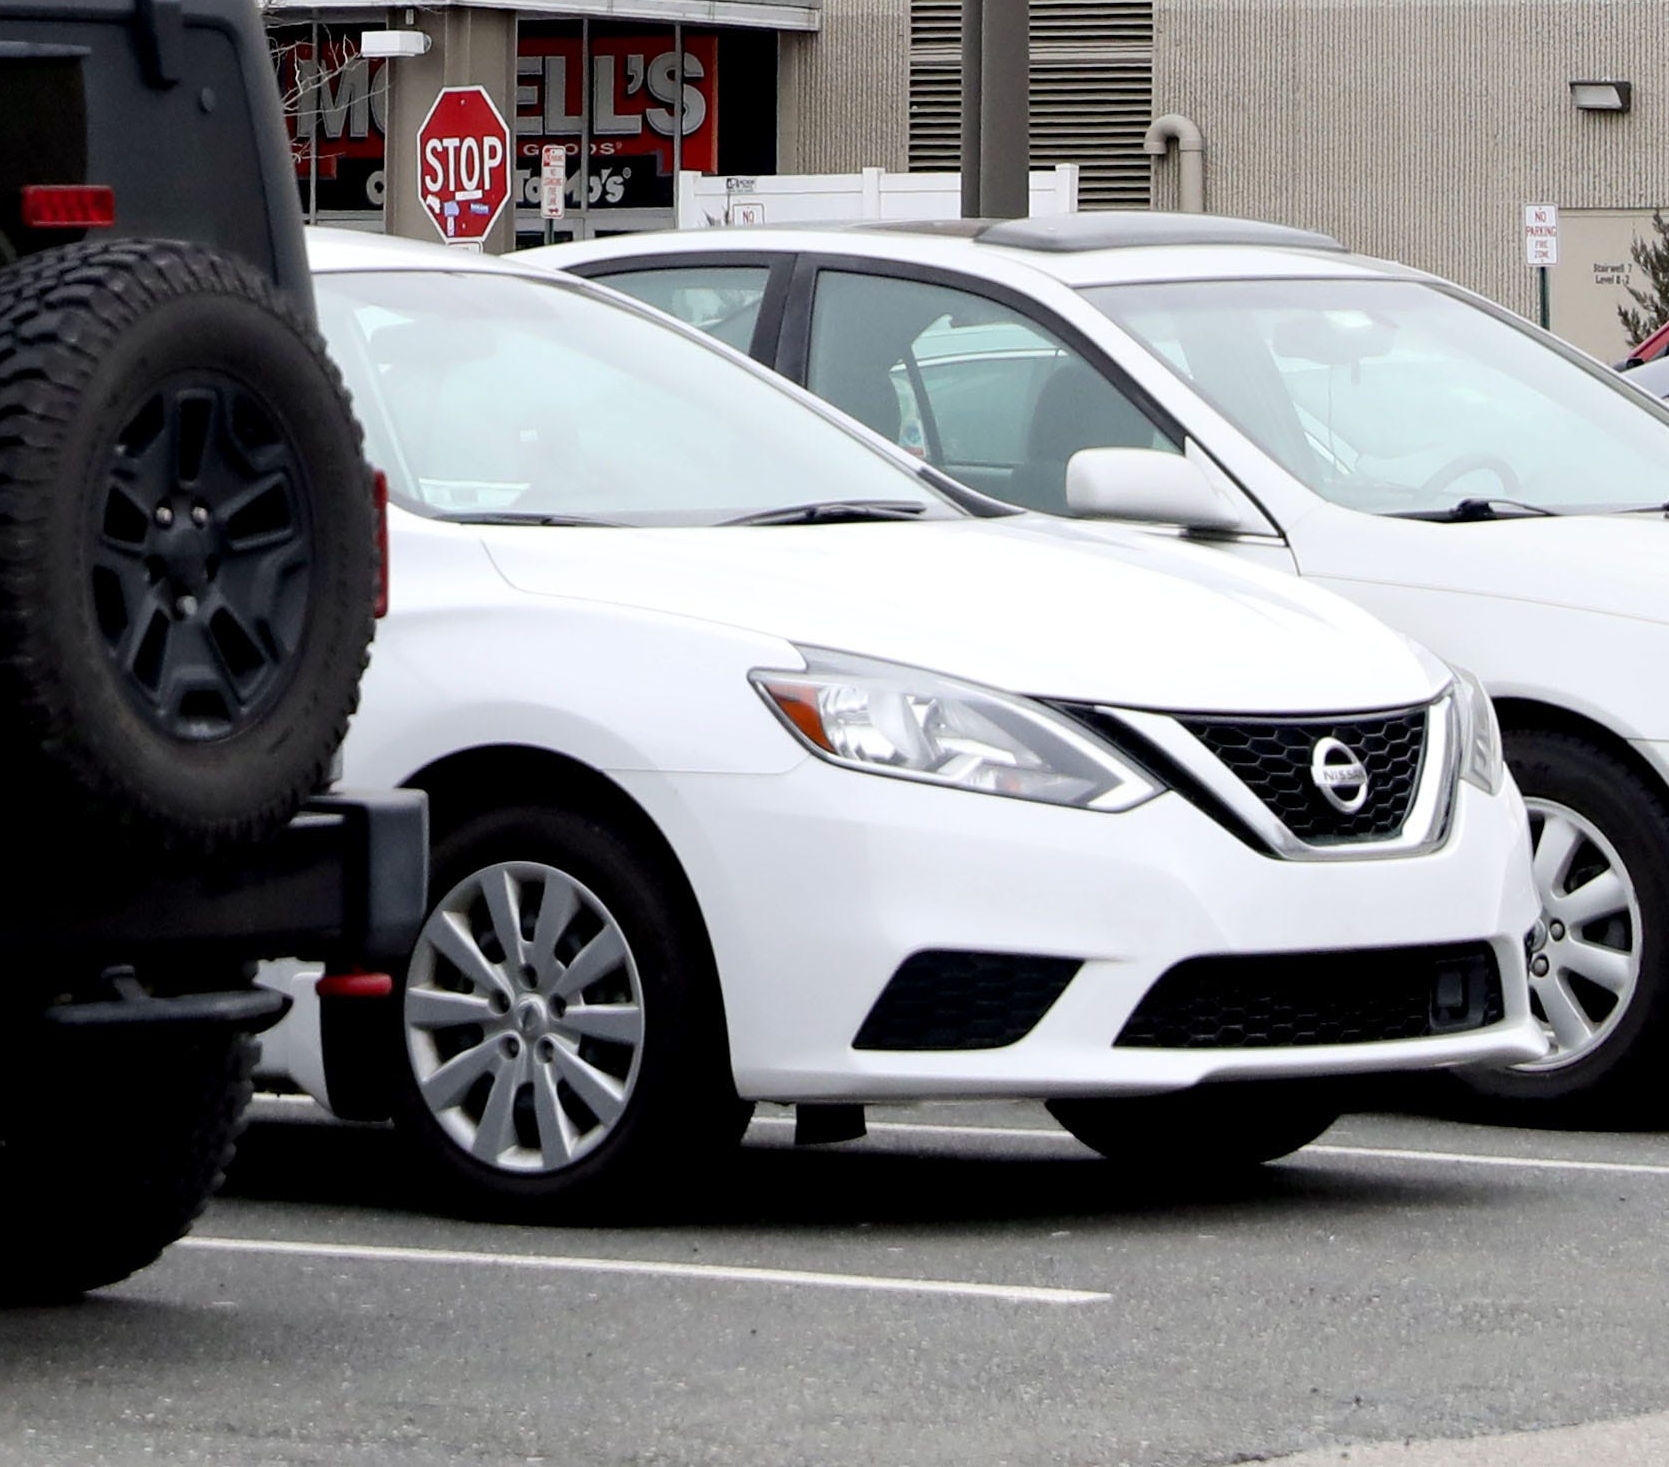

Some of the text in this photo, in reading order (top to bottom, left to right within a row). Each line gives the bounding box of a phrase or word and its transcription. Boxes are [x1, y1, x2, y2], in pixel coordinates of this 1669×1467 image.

[296, 51, 706, 138] MELL'S
[424, 135, 503, 193] STOP
[1526, 226, 1558, 237] PARKING
[1534, 210, 1547, 223] NO
